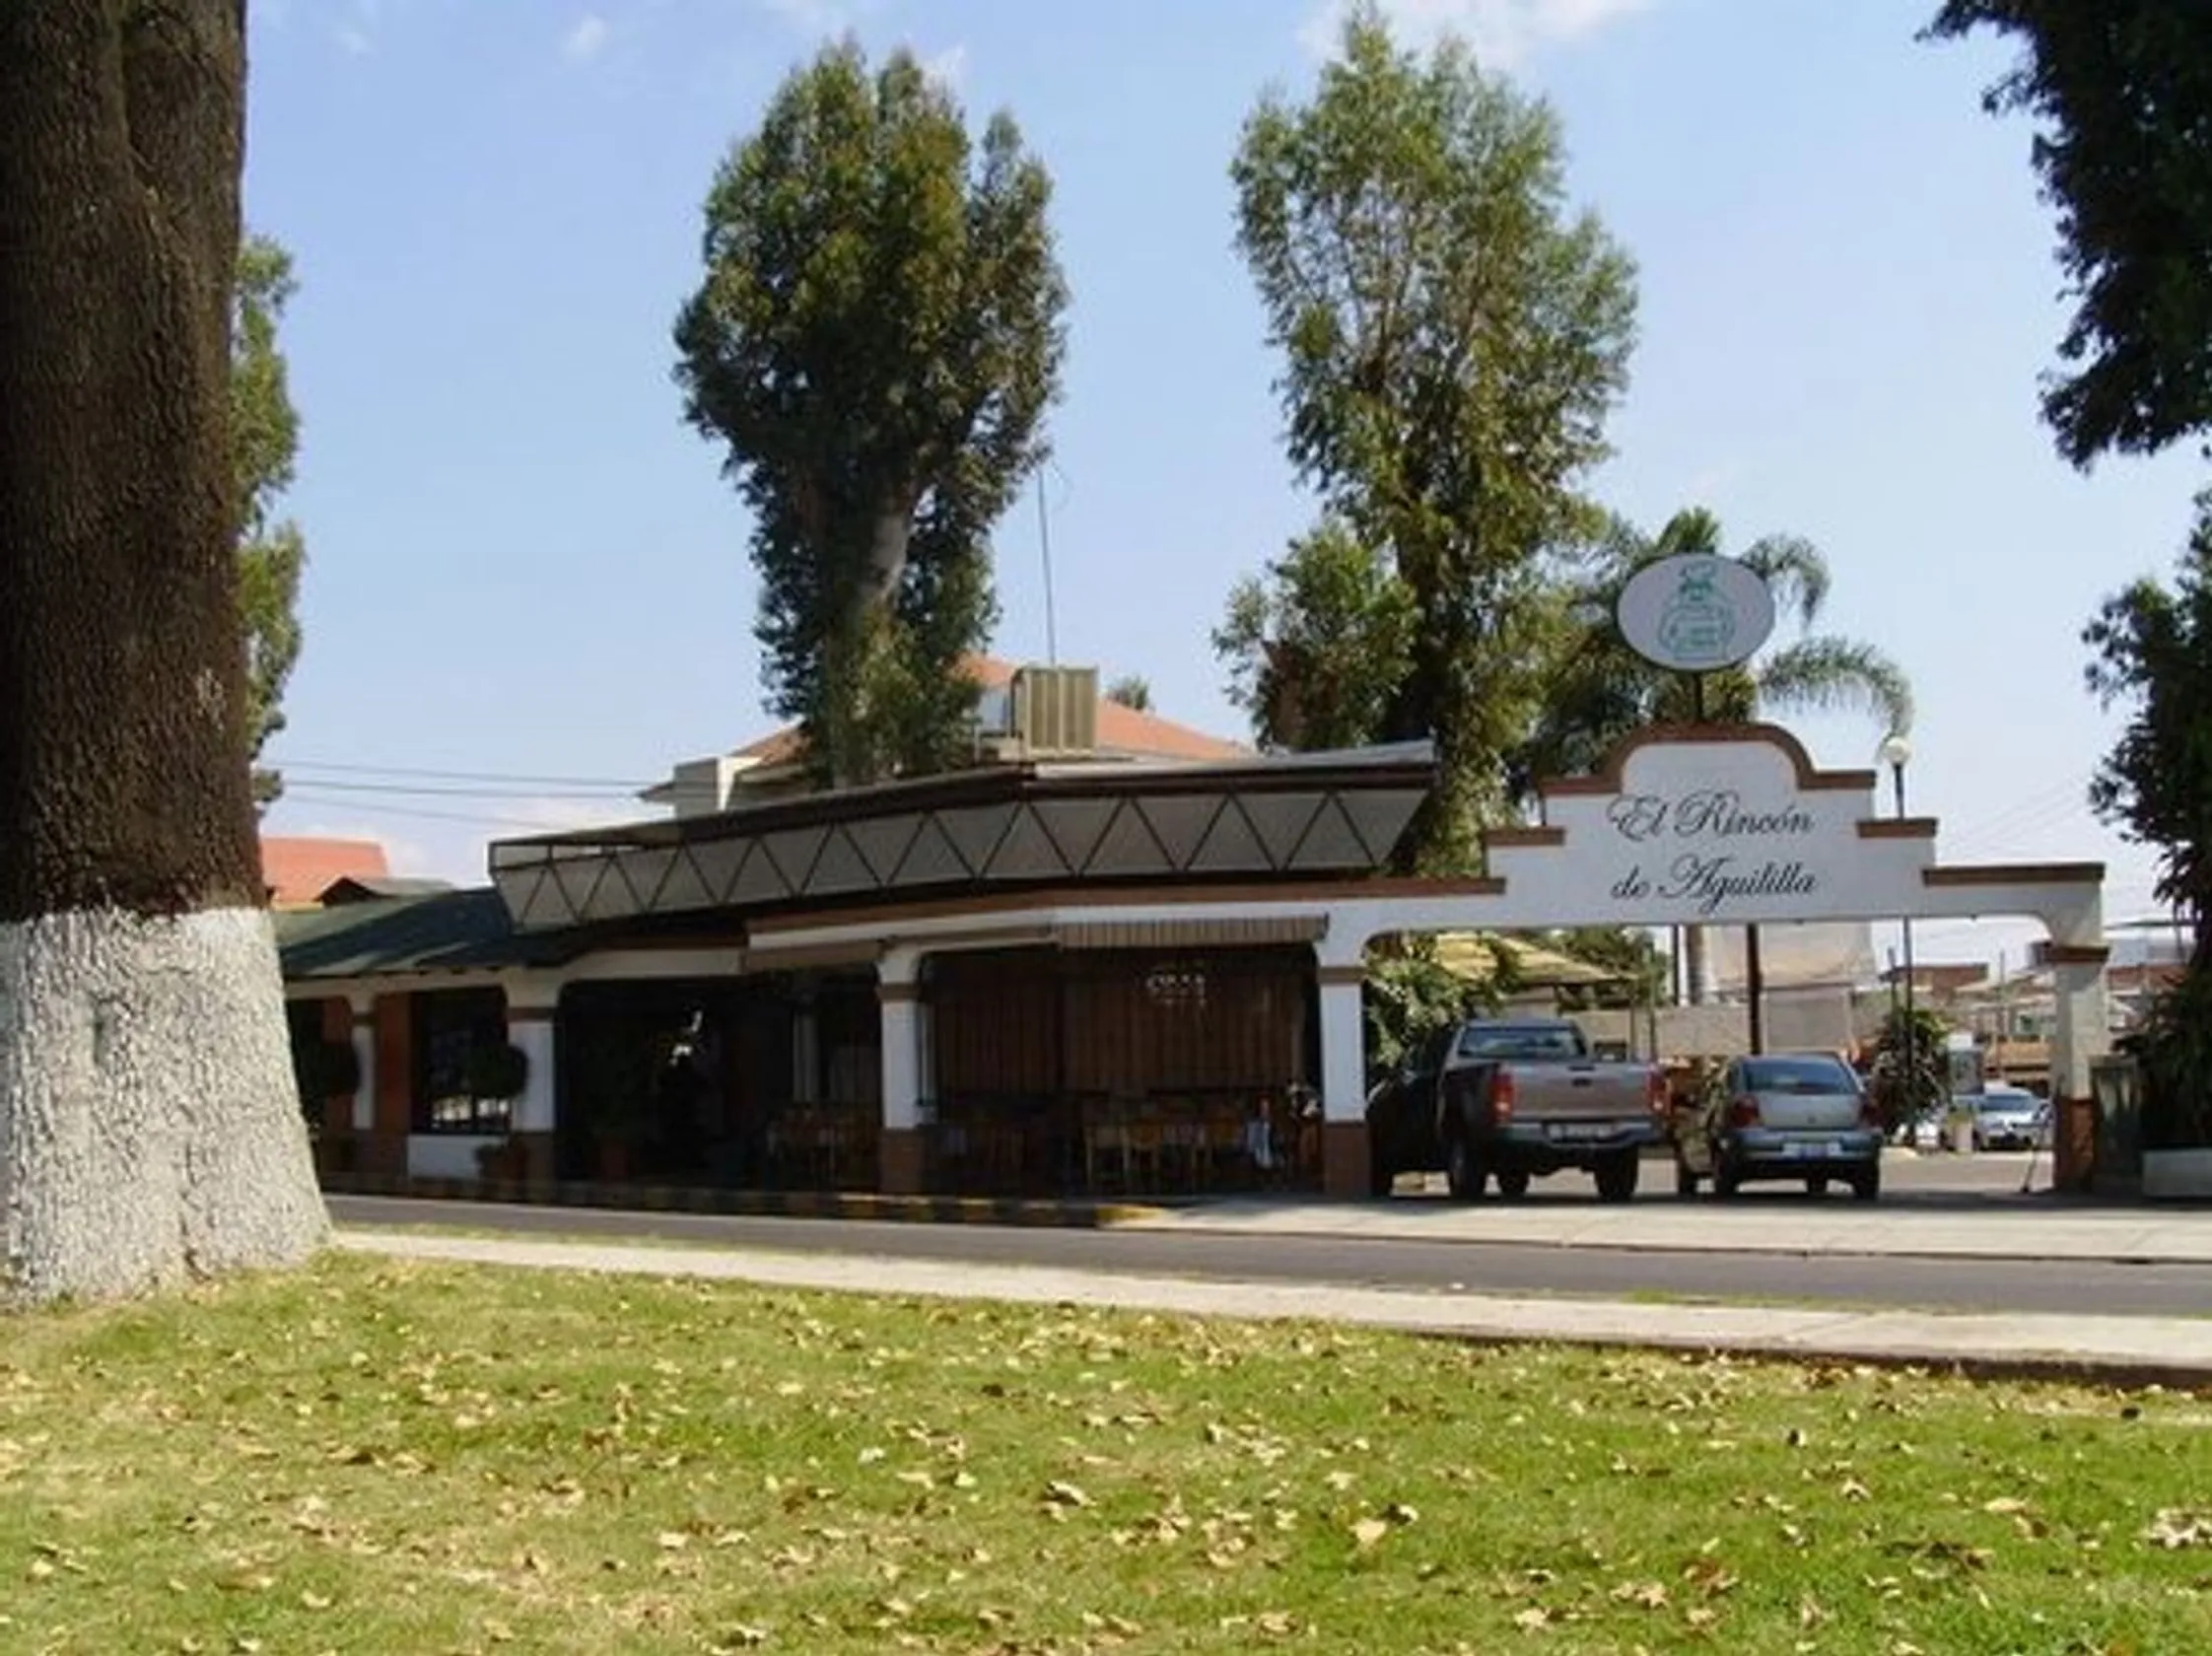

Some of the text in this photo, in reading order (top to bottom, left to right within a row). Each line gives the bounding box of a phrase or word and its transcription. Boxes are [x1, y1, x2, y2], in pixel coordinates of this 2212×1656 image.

[1607, 790, 1814, 841] El Rincón
[1610, 853, 1817, 914] de Aguililla
